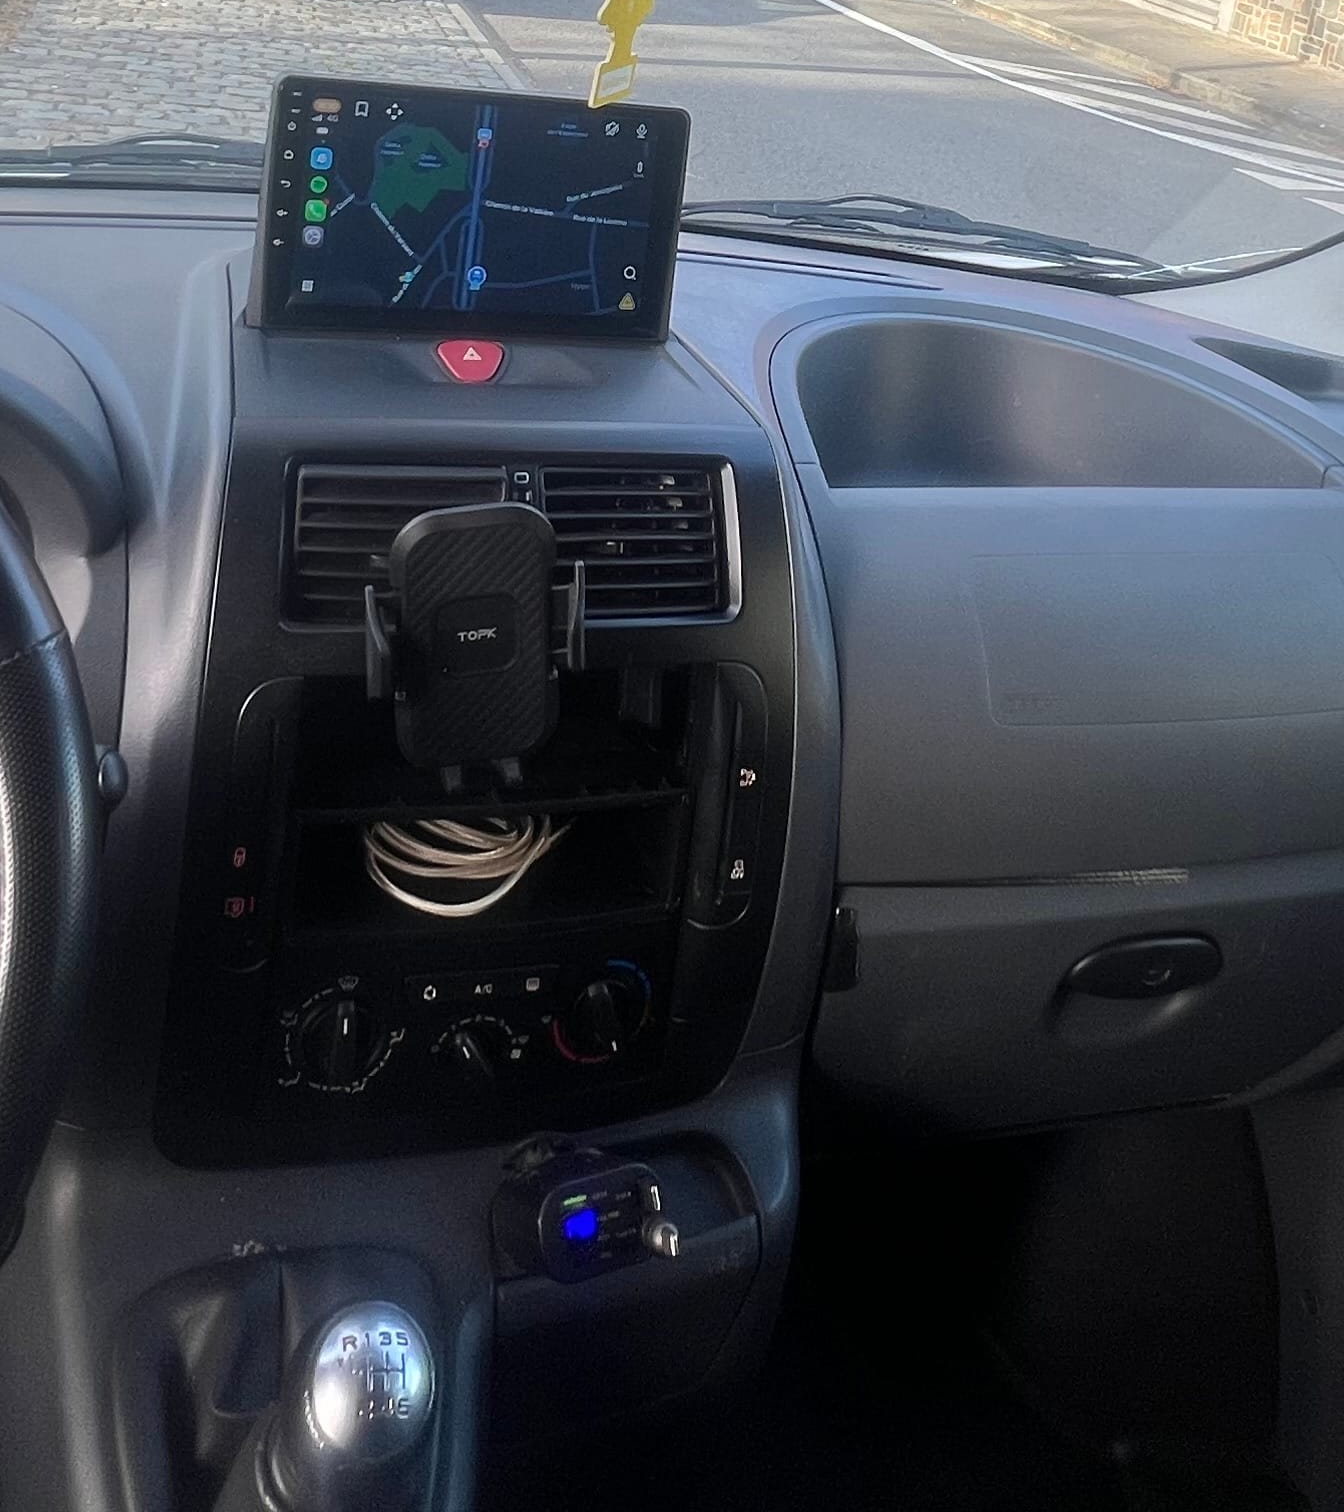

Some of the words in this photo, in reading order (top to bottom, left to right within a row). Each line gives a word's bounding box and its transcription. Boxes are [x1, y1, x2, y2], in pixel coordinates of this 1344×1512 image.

[457, 627, 497, 643] TOPK
[474, 984, 493, 994] A/C
[342, 1335, 358, 1352] R
[379, 1331, 392, 1346] 3
[395, 1331, 409, 1346] 5
